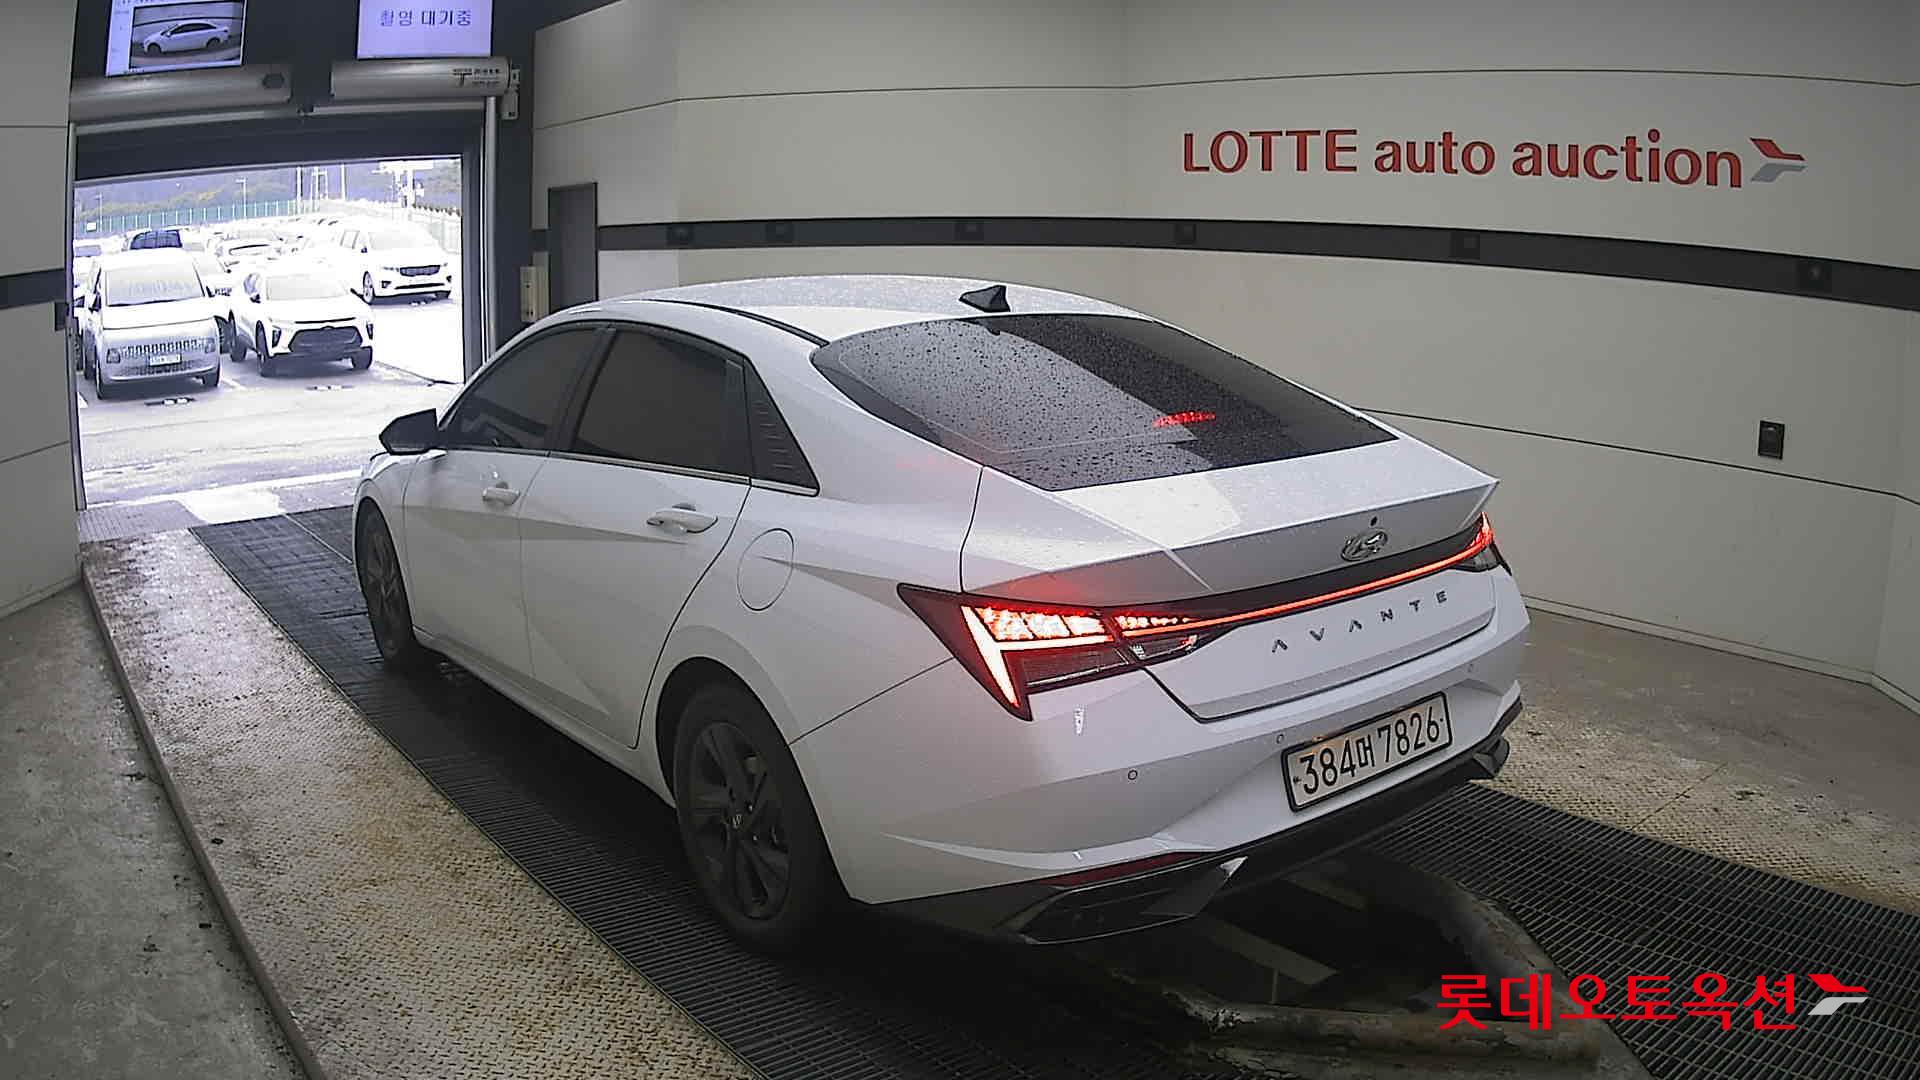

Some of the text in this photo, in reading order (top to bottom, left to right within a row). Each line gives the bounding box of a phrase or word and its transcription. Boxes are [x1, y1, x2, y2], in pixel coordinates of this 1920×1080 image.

[421, 9, 472, 27] 대기중
[1183, 128, 1743, 188] LOTTE auto auction
[1272, 590, 1448, 653] AVANTE
